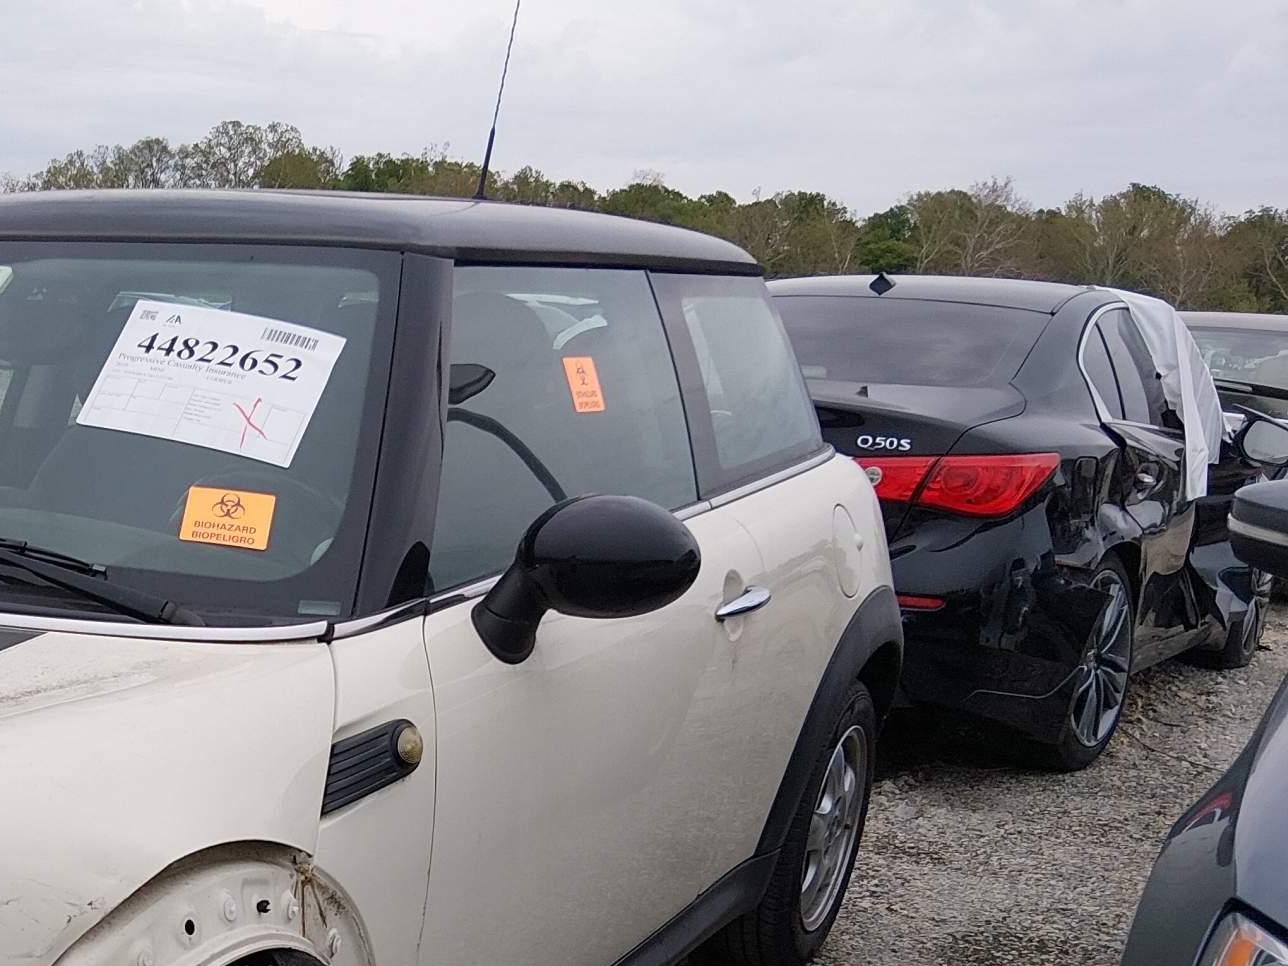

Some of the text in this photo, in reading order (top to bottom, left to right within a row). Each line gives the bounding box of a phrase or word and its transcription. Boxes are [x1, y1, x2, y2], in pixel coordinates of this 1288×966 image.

[137, 332, 303, 382] 44822652
[118, 352, 166, 367] Progressive
[168, 359, 203, 373] Casualty
[205, 365, 247, 380] Insurance
[856, 435, 912, 451] Q50S
[193, 520, 257, 535] BIOHAZARD
[191, 530, 255, 545] BIOPELIGRO
